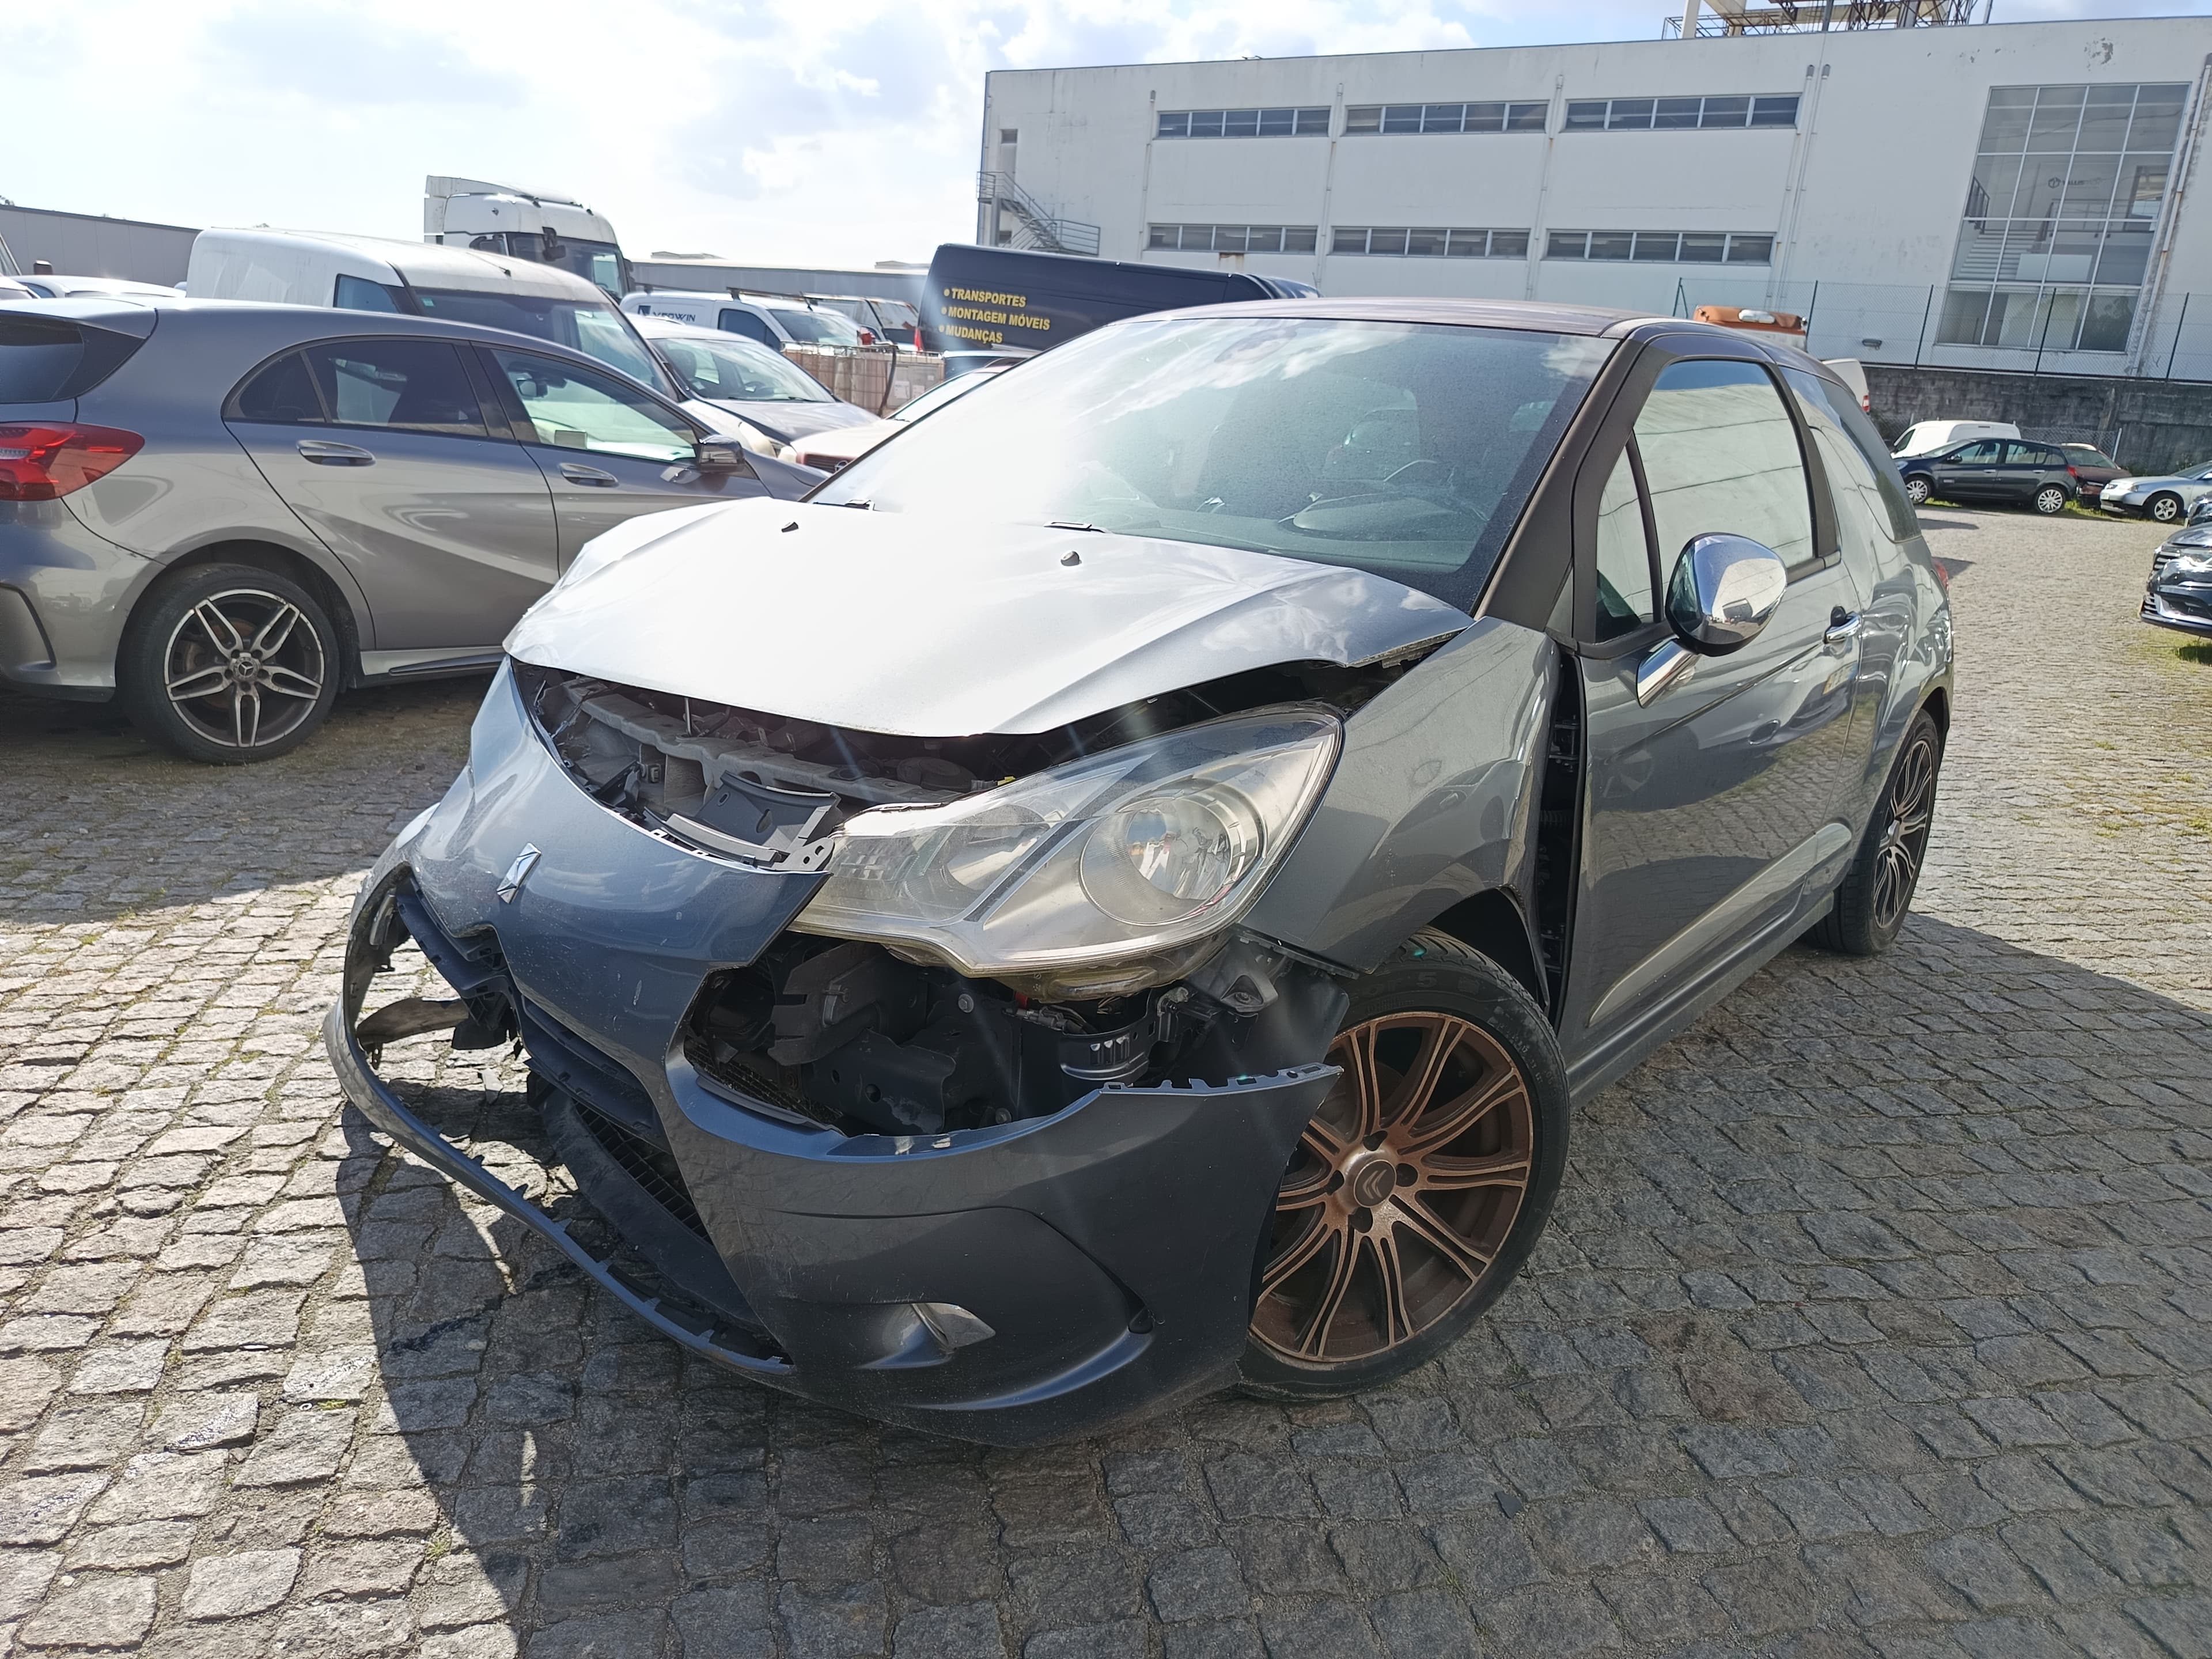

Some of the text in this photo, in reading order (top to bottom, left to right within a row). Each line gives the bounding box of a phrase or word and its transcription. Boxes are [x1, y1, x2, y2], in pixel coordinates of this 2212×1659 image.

[952, 288, 1026, 308] TRANSPORTES
[948, 307, 1050, 330] MONTAGEM MÓVEIS
[946, 325, 1003, 343] MUDANÇAS
